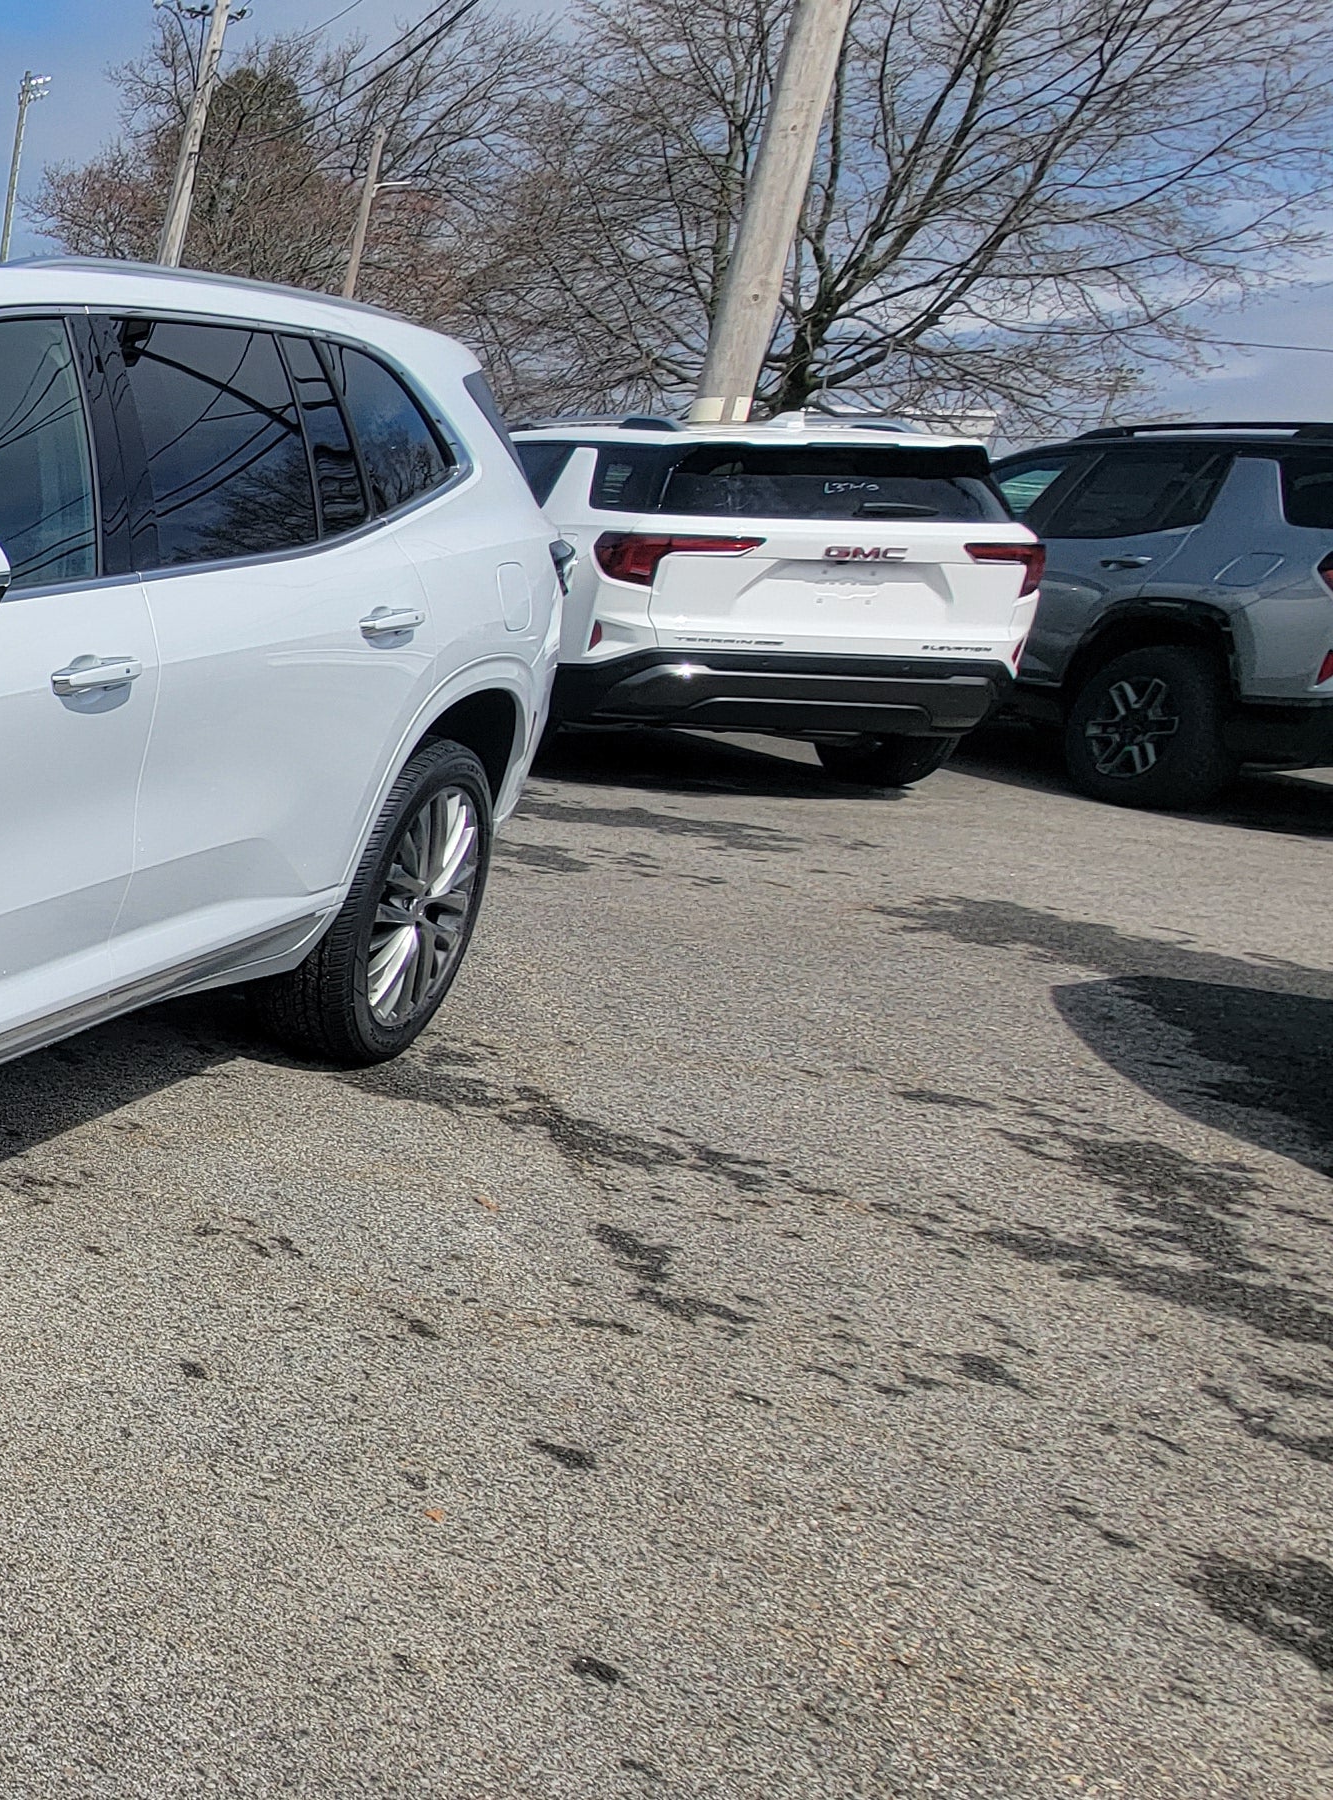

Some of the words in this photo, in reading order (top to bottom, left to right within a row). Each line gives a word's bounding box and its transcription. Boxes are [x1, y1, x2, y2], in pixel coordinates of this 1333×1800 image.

[824, 546, 909, 560] GMC
[674, 635, 754, 646] TERRAIN
[921, 644, 993, 653] ELEVATION
